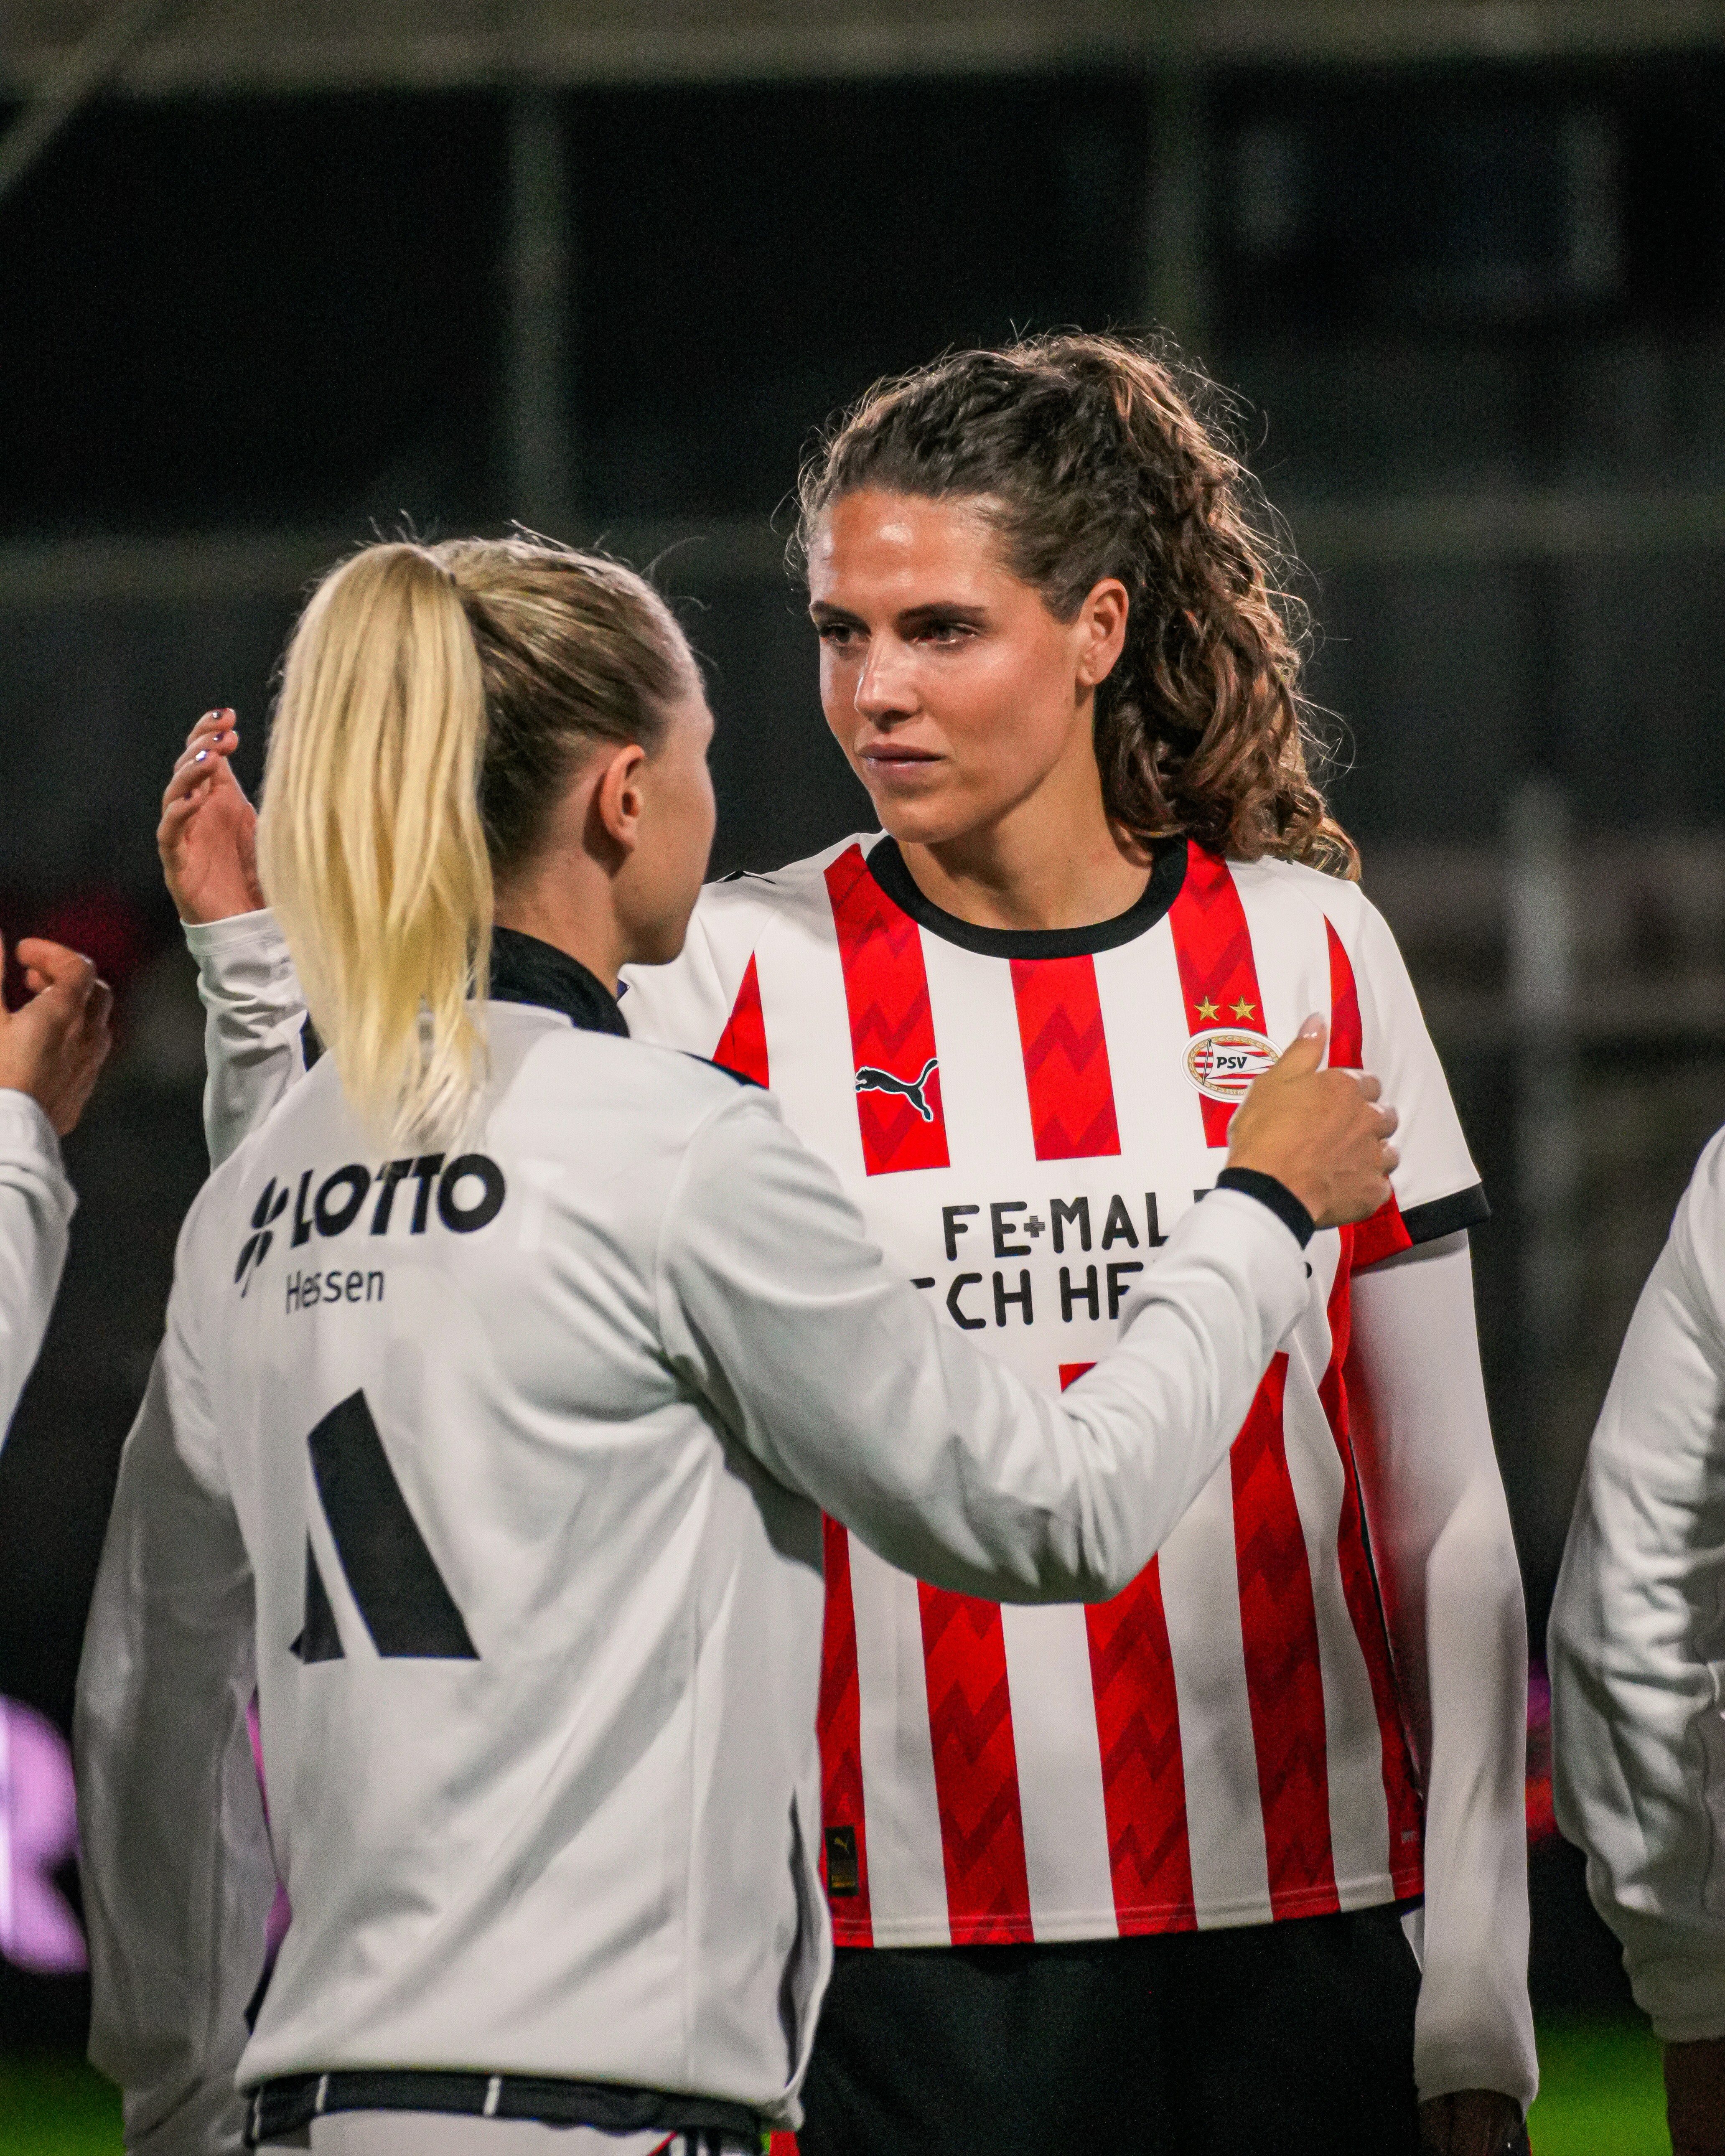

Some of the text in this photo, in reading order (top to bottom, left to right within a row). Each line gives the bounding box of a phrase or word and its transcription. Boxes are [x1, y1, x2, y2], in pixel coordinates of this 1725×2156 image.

[1216, 1056, 1247, 1069] PSV
[291, 1153, 506, 1248] LOTTO
[942, 1189, 1215, 1261] FE+MAL
[911, 1269, 1033, 1330] CH
